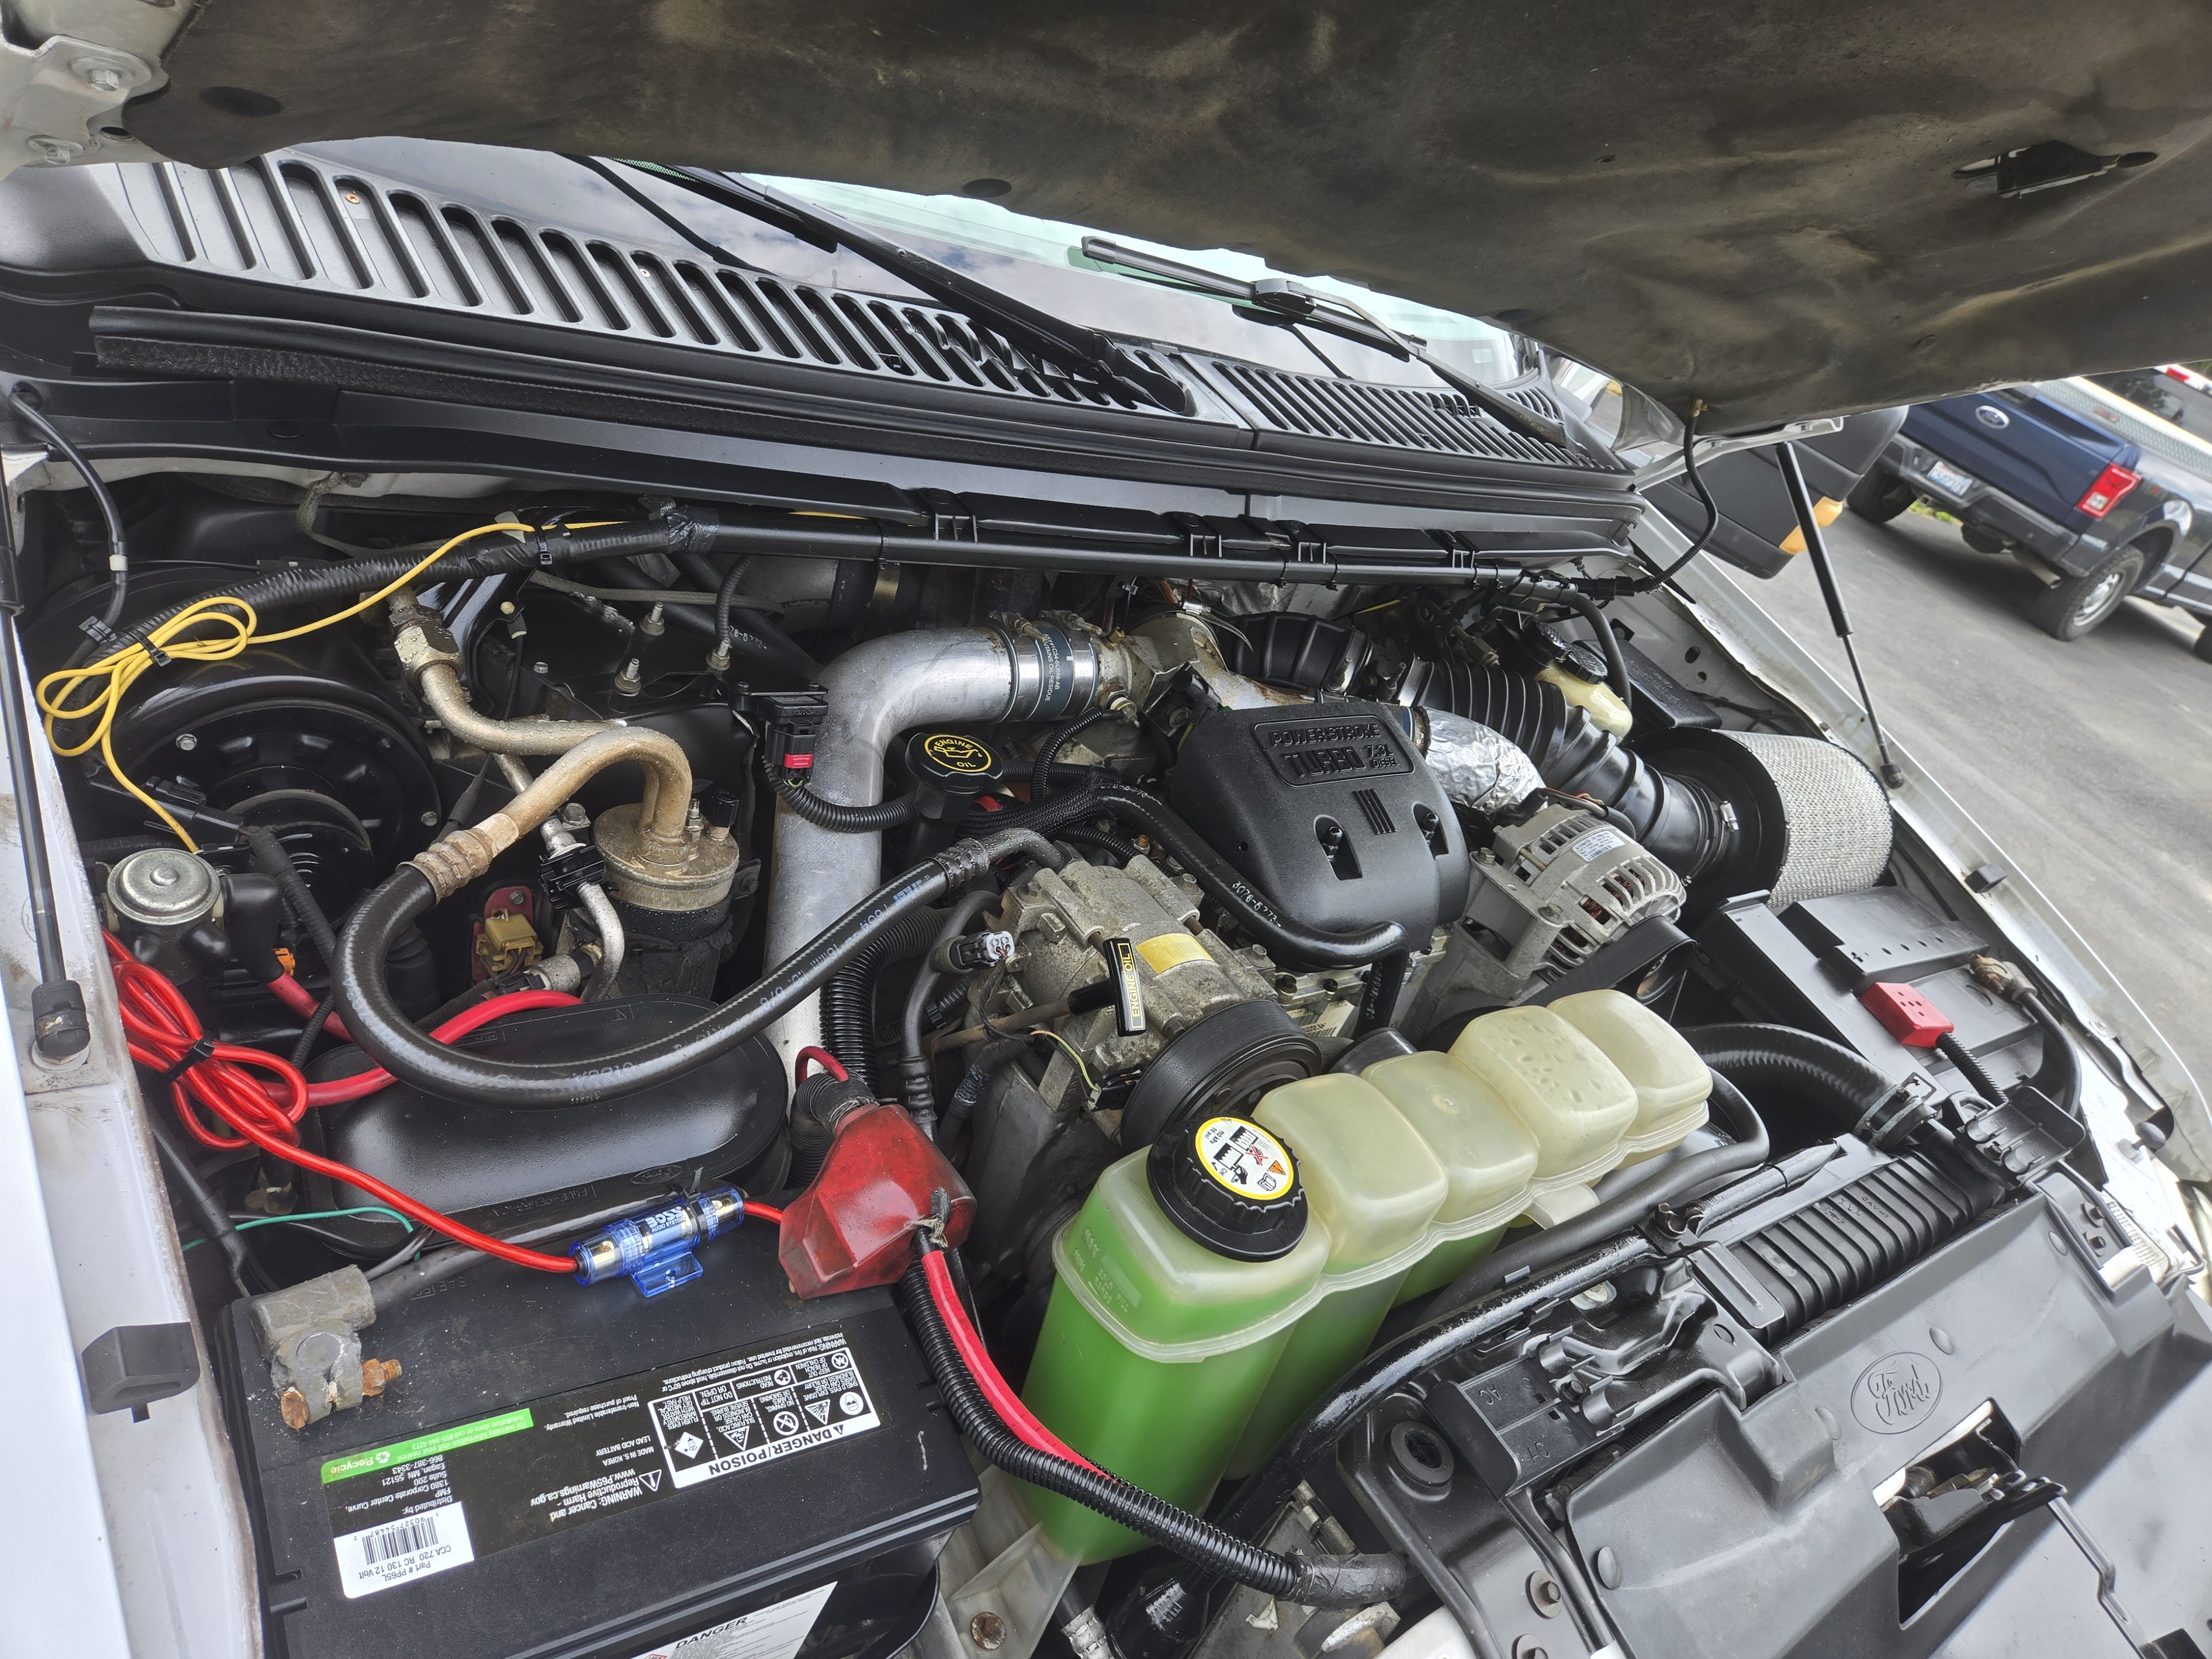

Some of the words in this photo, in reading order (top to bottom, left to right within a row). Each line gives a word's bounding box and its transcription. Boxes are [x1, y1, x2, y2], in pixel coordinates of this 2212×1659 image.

[1044, 675, 1053, 701] RESIDUE
[1327, 723, 1381, 741] STROKE
[934, 738, 973, 749] ENGINE
[1365, 743, 1394, 758] 7.3L
[1283, 745, 1366, 778] TURBO
[1371, 757, 1400, 769] DIESEL
[1123, 953, 1133, 971] OIL
[1126, 973, 1140, 1016] ENGINE
[1209, 1135, 1219, 1144] kPa
[1216, 1129, 1224, 1138] 110
[1218, 1167, 1228, 1177] OK
[644, 1204, 685, 1229] BOSS
[650, 1222, 666, 1233] AUDIO
[806, 1345, 818, 1354] Risk
[816, 1337, 846, 1351] WARNING:
[771, 1350, 794, 1363] explosion
[736, 1364, 745, 1373] not
[744, 1362, 753, 1370] Do
[795, 1358, 821, 1370] CHILDREN
[804, 1363, 821, 1373] REACH
[706, 1366, 738, 1380] disassemble,
[807, 1370, 818, 1378] OUT
[817, 1366, 830, 1375] KEEP
[827, 1369, 854, 1383] BLINDNESS
[680, 1378, 696, 1387] above
[695, 1374, 707, 1384] heat
[735, 1374, 771, 1389] INSTRUCTIONS
[759, 1380, 774, 1389] READ
[803, 1379, 821, 1389] INJURY
[829, 1379, 840, 1387] CAN
[839, 1375, 855, 1385] GASES
[841, 1380, 858, 1390] SHIELD
[698, 1387, 717, 1399] OPEN.
[716, 1384, 727, 1394] OR
[813, 1383, 830, 1392] CAUSE
[1868, 1361, 1930, 1425] Ford
[622, 1393, 637, 1404] Proof
[676, 1394, 691, 1404] HELP
[709, 1393, 722, 1404] NOT
[721, 1390, 733, 1400] DO
[758, 1391, 782, 1403] SMOKING
[771, 1394, 792, 1405] FLAMES
[802, 1388, 828, 1401] EXPLOSIVE
[589, 1398, 615, 1412] purchase
[662, 1398, 677, 1407] FAST.
[680, 1399, 693, 1408] GET
[699, 1397, 710, 1406] TIP
[728, 1400, 748, 1411] SEVERE
[764, 1400, 786, 1412] SPARKS,
[785, 1399, 794, 1407] NO
[563, 1405, 590, 1419] required.
[593, 1400, 639, 1418] Non-transferable
[660, 1408, 681, 1419] WATER.
[680, 1405, 695, 1413] WITH
[709, 1405, 729, 1416] BURNS.
[721, 1406, 750, 1419] BLINDNESS
[490, 1413, 524, 1428] AutoNation
[571, 1412, 594, 1425] Limited
[661, 1410, 697, 1425] IMMEDIATELY
[681, 1416, 698, 1426] FLUSH
[723, 1415, 741, 1425] CAUSE
[740, 1411, 753, 1420] CAN
[473, 1422, 491, 1433] store
[514, 1421, 526, 1430] For
[543, 1417, 572, 1432] Warranty.
[666, 1421, 681, 1430] EYES
[729, 1416, 755, 1429] SULFURIC
[453, 1430, 466, 1438] call
[466, 1427, 474, 1435] or
[488, 1423, 515, 1437] warranty
[451, 1432, 488, 1447] information
[620, 1439, 635, 1449] ACID
[635, 1434, 651, 1445] LEAD
[421, 1444, 437, 1455] your
[437, 1442, 451, 1451] visit
[594, 1443, 621, 1457] BATTERY
[636, 1445, 654, 1457] MADE
[708, 1428, 832, 1475] DANGER/POISON
[396, 1449, 421, 1462] nearest
[622, 1452, 630, 1460] S.
[629, 1450, 637, 1458] IN
[328, 1454, 374, 1475] Recycle
[391, 1453, 444, 1474] 866-387-3343
[602, 1454, 623, 1467] KOREA
[420, 1460, 446, 1475] Eagan,
[380, 1473, 405, 1486] 55121
[406, 1469, 421, 1479] MN
[427, 1470, 447, 1481] Suite
[413, 1475, 429, 1486] 200
[429, 1478, 449, 1490] 1380
[394, 1483, 430, 1500] Corporate
[433, 1486, 451, 1498] FMP
[528, 1468, 635, 1506] www.P65Warnings.ca.gov
[586, 1475, 639, 1500] Reproductive
[369, 1494, 394, 1507] Center
[562, 1492, 587, 1506] Harm
[597, 1485, 643, 1507] WARNING:
[345, 1500, 369, 1514] Curve,
[414, 1495, 452, 1512] Distributed
[566, 1499, 598, 1516] Cancer
[400, 1504, 414, 1516] by:
[549, 1507, 568, 1522] and
[398, 1515, 425, 1528] 90327
[368, 1524, 396, 1537] 54487
[418, 1550, 435, 1561] 720
[434, 1544, 452, 1556] CCA
[386, 1559, 402, 1571] 130
[403, 1555, 415, 1566] RC
[414, 1560, 431, 1572] Part
[357, 1568, 374, 1579] Volt
[374, 1564, 384, 1574] 12
[380, 1567, 407, 1582] PP65L
[407, 1565, 414, 1574] #
[675, 1617, 747, 1649] DANGER
